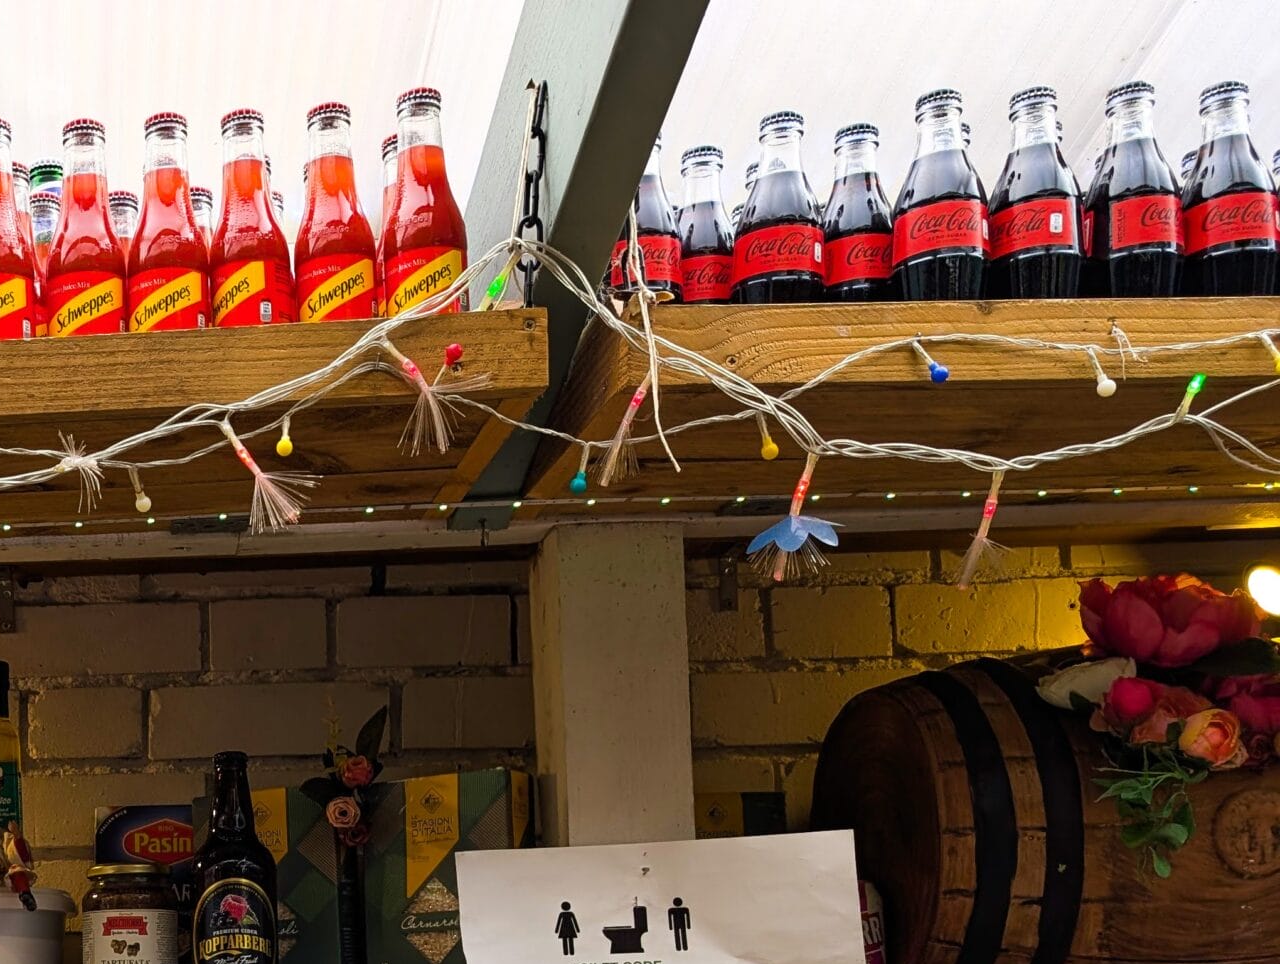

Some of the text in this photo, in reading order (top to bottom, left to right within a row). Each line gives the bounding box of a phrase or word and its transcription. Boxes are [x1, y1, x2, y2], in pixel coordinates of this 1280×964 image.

[745, 232, 812, 264] Coca-Cola
[135, 285, 191, 330] Schweppes
[213, 277, 249, 315] weppes
[308, 272, 365, 318] Schweppes
[394, 263, 451, 314] Schweppes
[57, 290, 114, 333] Schweppes
